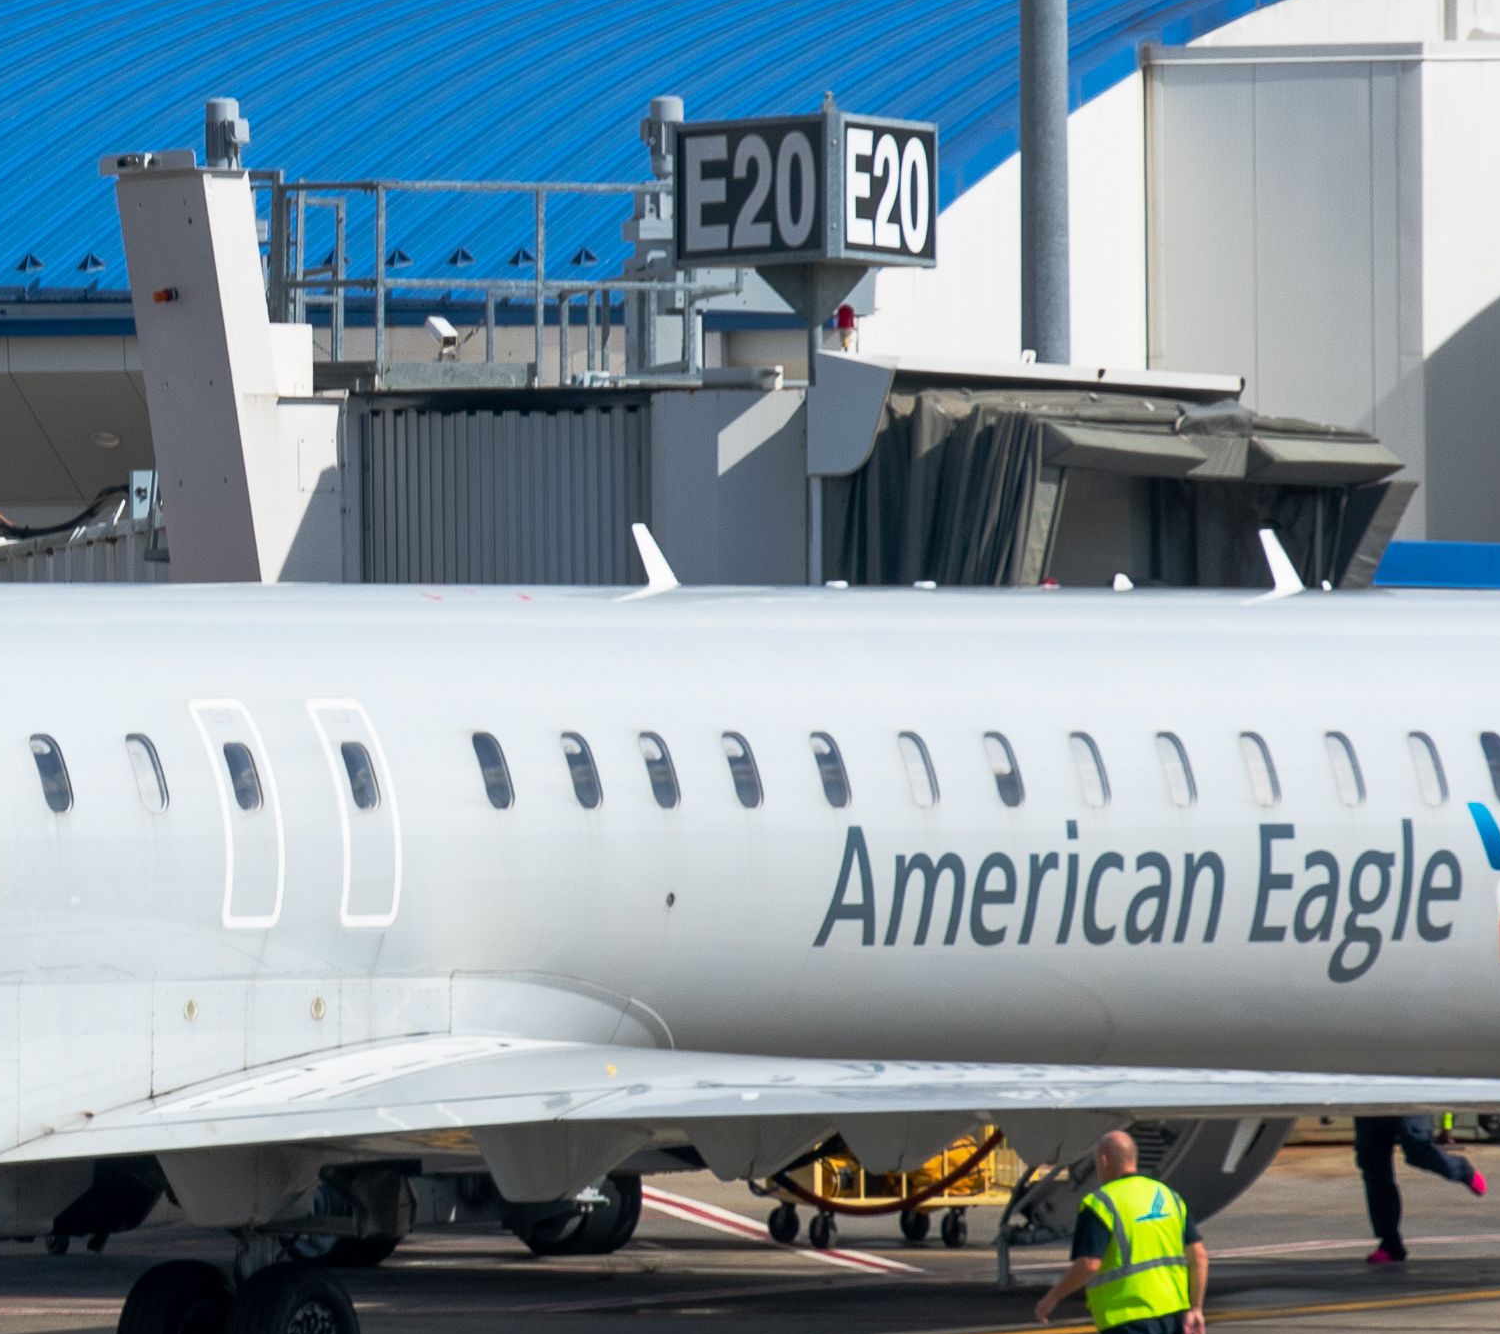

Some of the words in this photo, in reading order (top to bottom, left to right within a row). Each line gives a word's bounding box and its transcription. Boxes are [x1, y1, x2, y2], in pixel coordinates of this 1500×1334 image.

[684, 130, 817, 252] E20
[846, 128, 930, 254] E20
[812, 820, 1226, 948] American
[1248, 819, 1464, 984] Eagle
